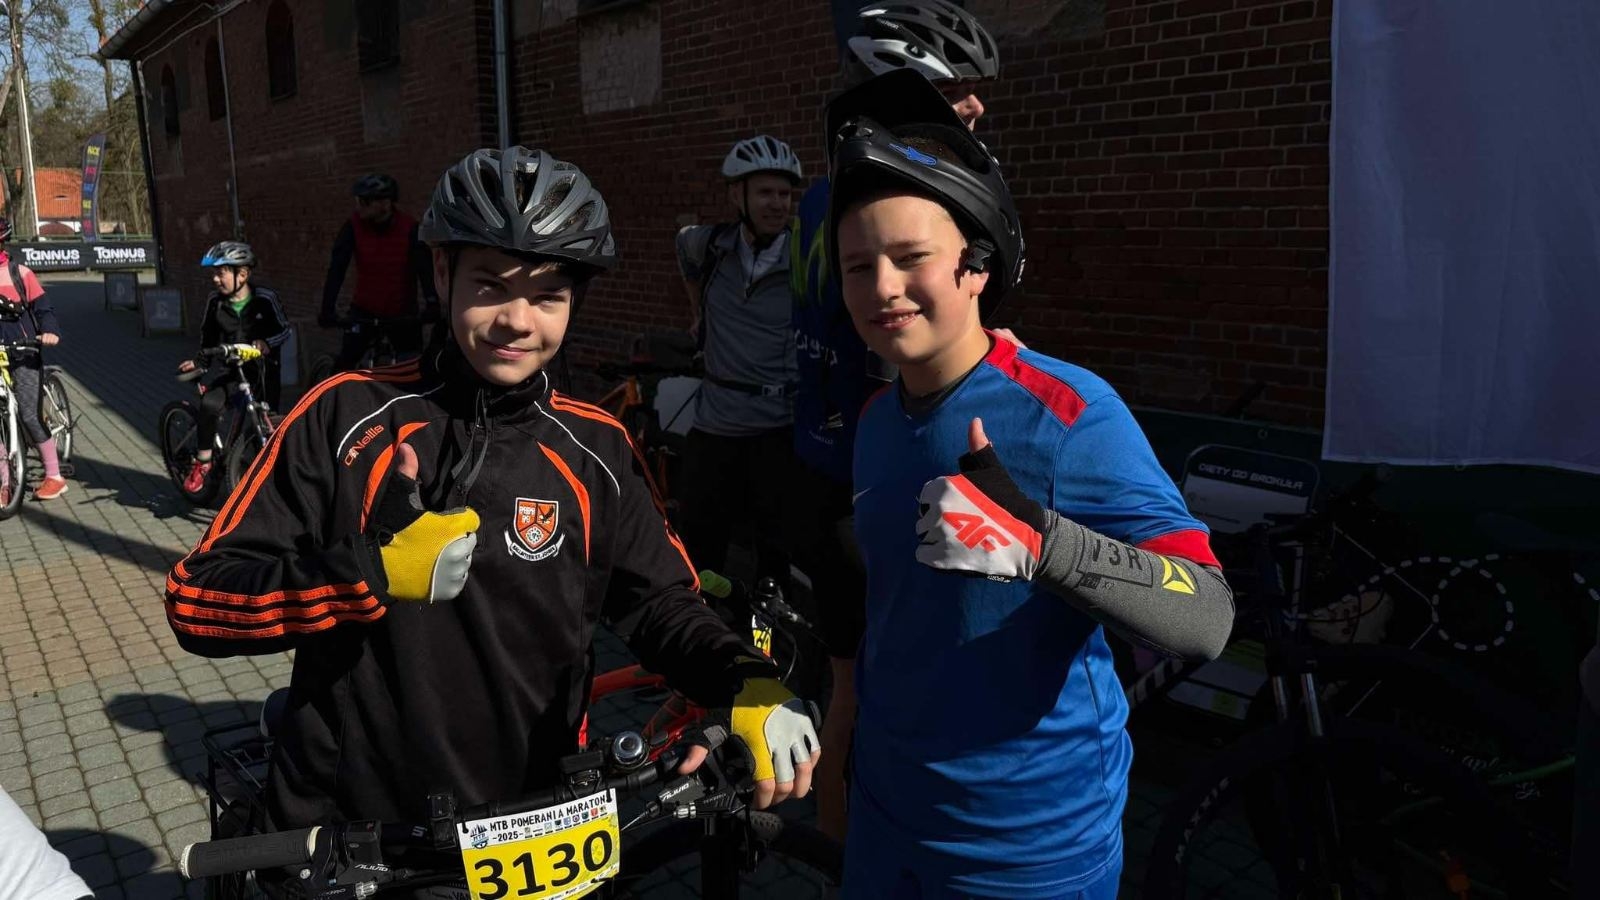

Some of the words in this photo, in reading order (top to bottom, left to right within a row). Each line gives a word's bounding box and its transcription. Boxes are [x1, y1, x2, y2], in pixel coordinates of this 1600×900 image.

[942, 511, 1012, 553] 4F
[489, 819, 508, 832] MTB
[566, 795, 607, 815] MARATON
[474, 829, 613, 900] 3130
